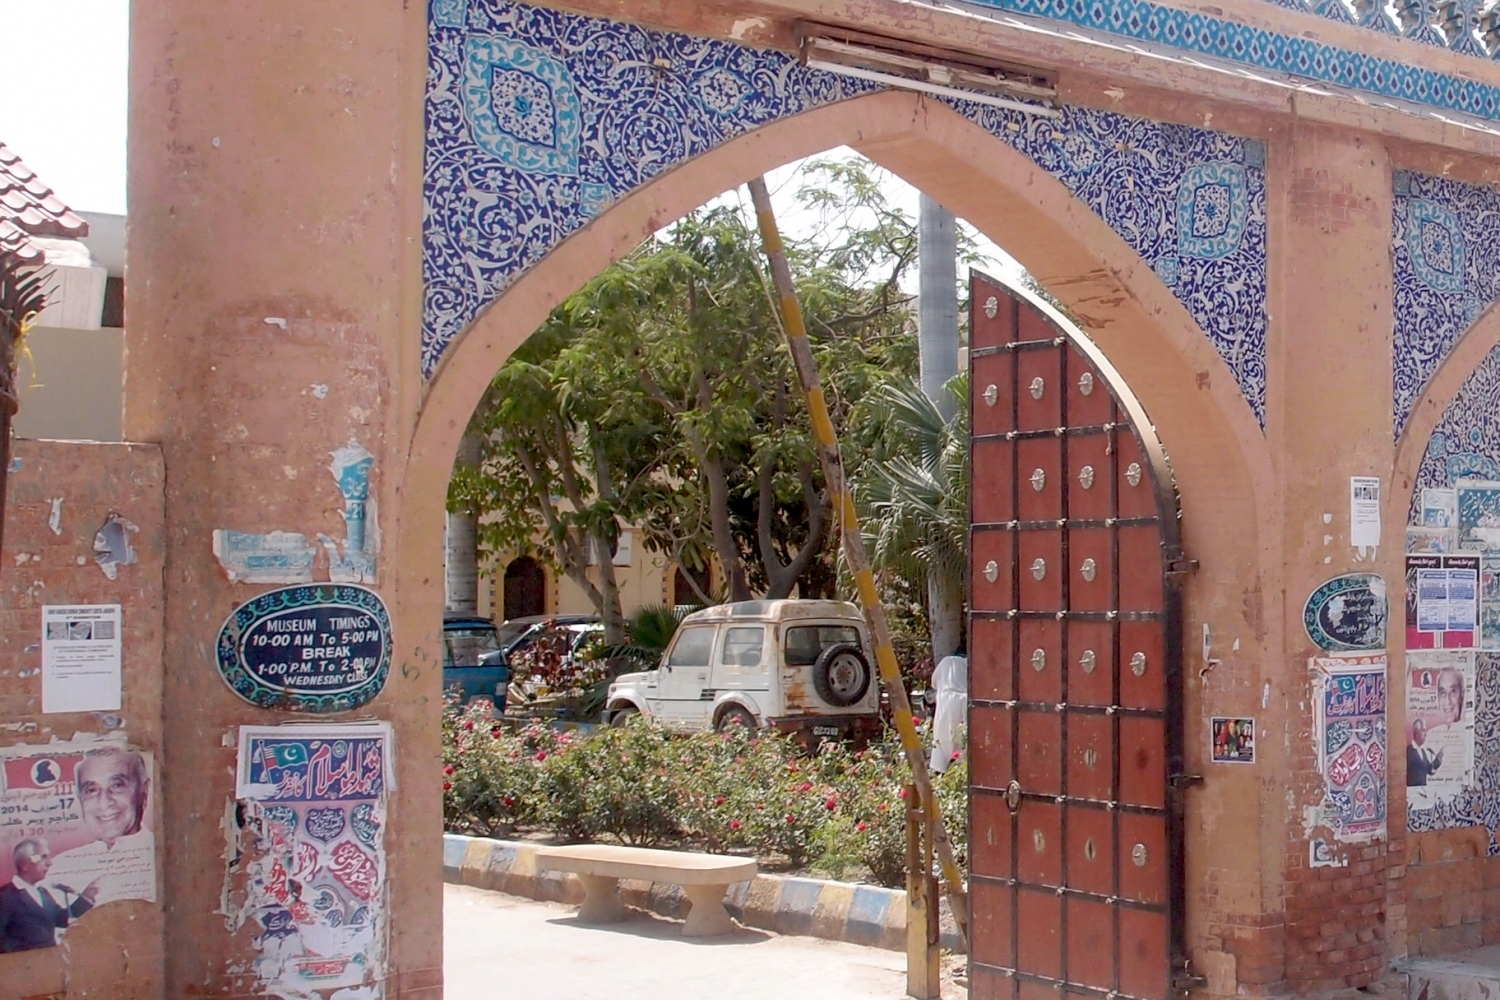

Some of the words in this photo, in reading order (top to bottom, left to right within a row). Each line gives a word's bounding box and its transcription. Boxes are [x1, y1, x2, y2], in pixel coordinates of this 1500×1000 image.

[267, 619, 316, 632] MUSEUM
[329, 616, 370, 629] TIMINGS
[253, 634, 290, 646] 10-00
[294, 634, 313, 645] AM
[341, 632, 365, 643] 5-00
[366, 630, 379, 641] PM
[302, 647, 351, 659] BREAK
[258, 663, 287, 675] 1-00
[364, 657, 376, 668] PM
[284, 674, 345, 685] WEDNESDAY
[1, 804, 29, 814] 2014
[59, 798, 75, 810] 17
